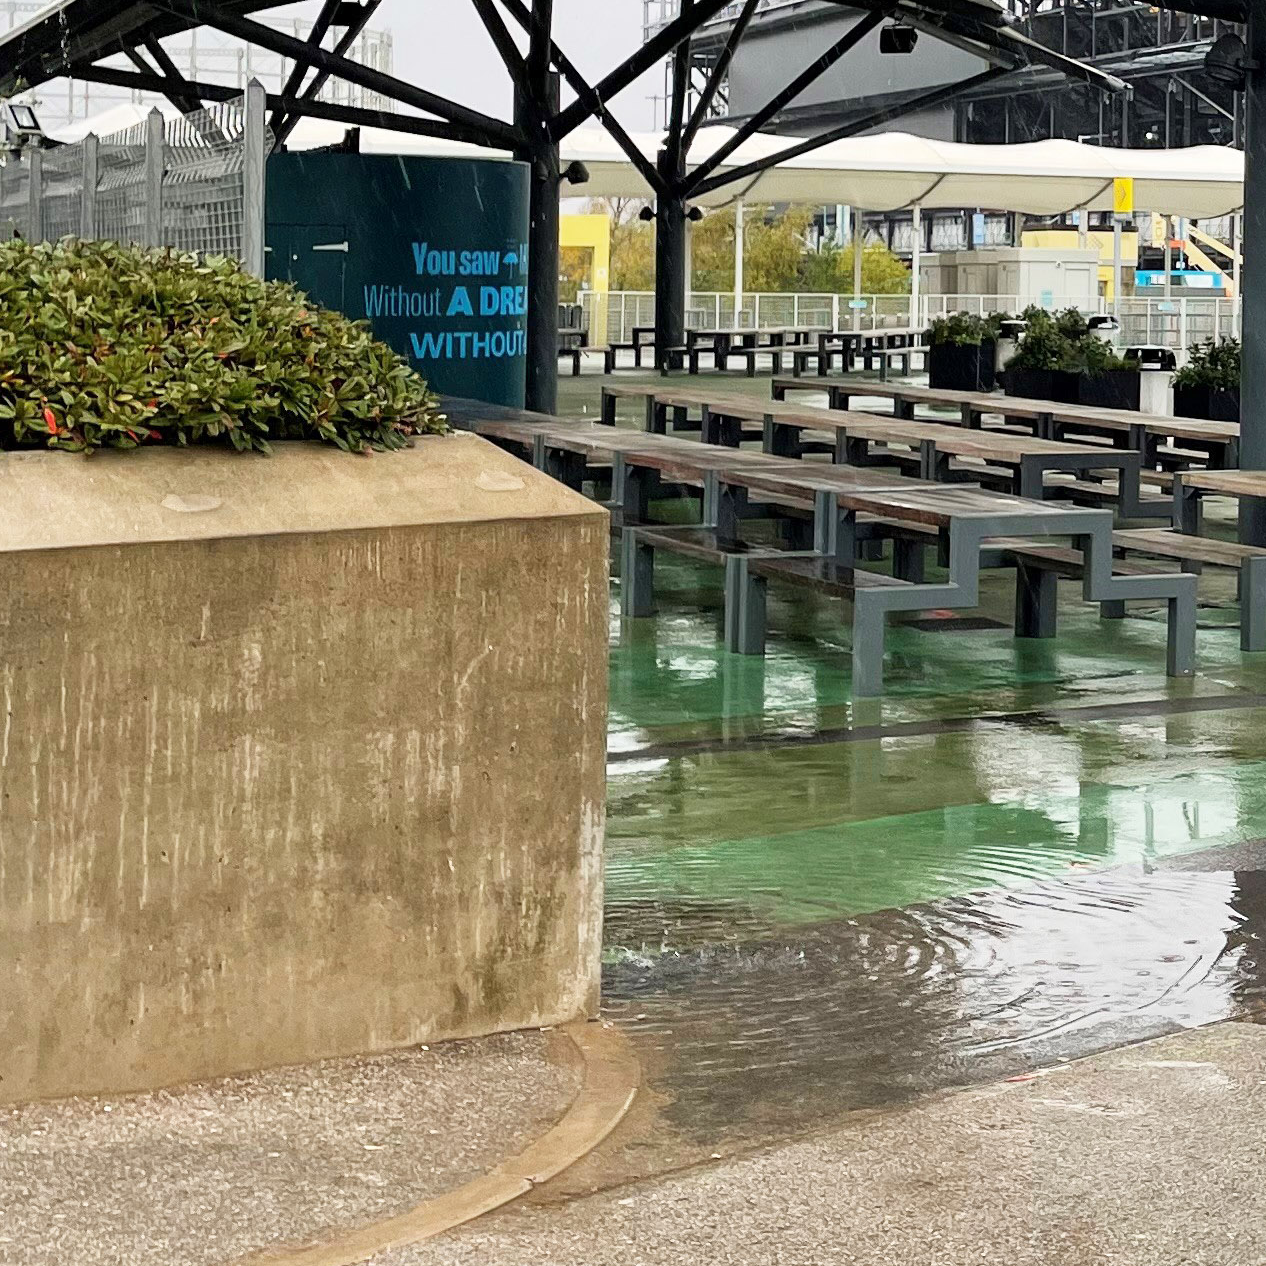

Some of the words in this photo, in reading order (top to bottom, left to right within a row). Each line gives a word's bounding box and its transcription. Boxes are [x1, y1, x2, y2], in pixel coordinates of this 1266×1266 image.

[412, 242, 455, 275] You
[459, 250, 500, 275] saw
[364, 285, 441, 317] Without
[446, 286, 474, 316] A
[479, 285, 528, 316] DRE
[410, 330, 523, 359] WITHOUT
